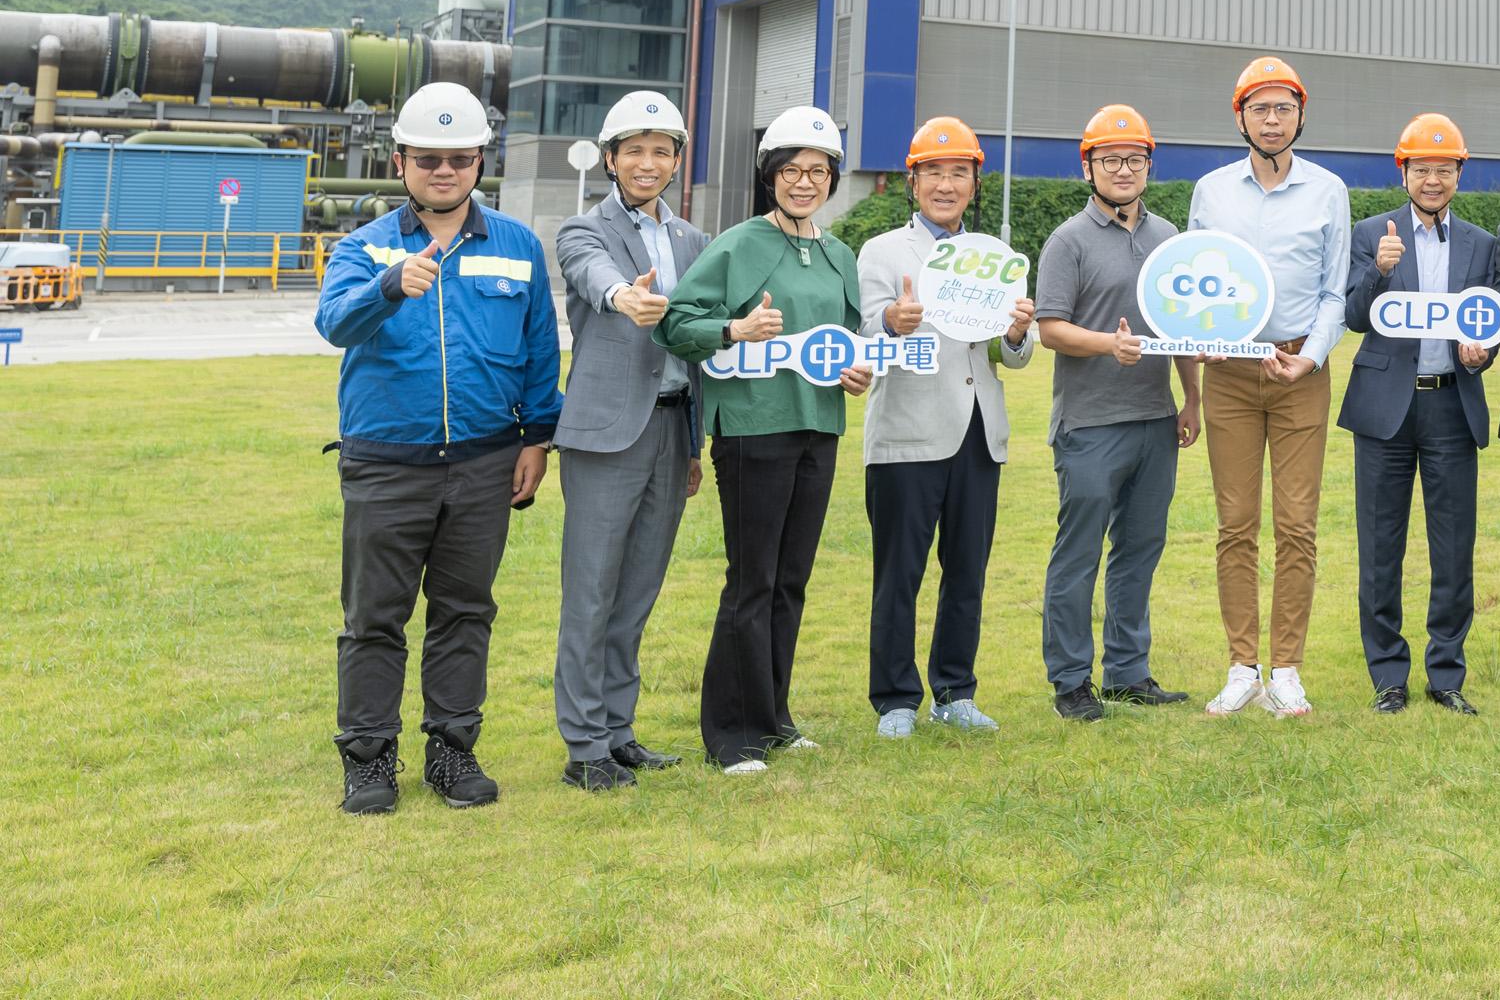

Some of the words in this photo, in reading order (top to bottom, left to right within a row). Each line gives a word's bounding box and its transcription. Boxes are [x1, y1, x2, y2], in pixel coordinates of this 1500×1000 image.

[927, 243, 1026, 284] 2050
[937, 278, 1006, 310] 碳中和
[1379, 300, 1450, 330] CLP
[864, 336, 936, 372] 中電
[1140, 339, 1272, 355] Decarbonisation
